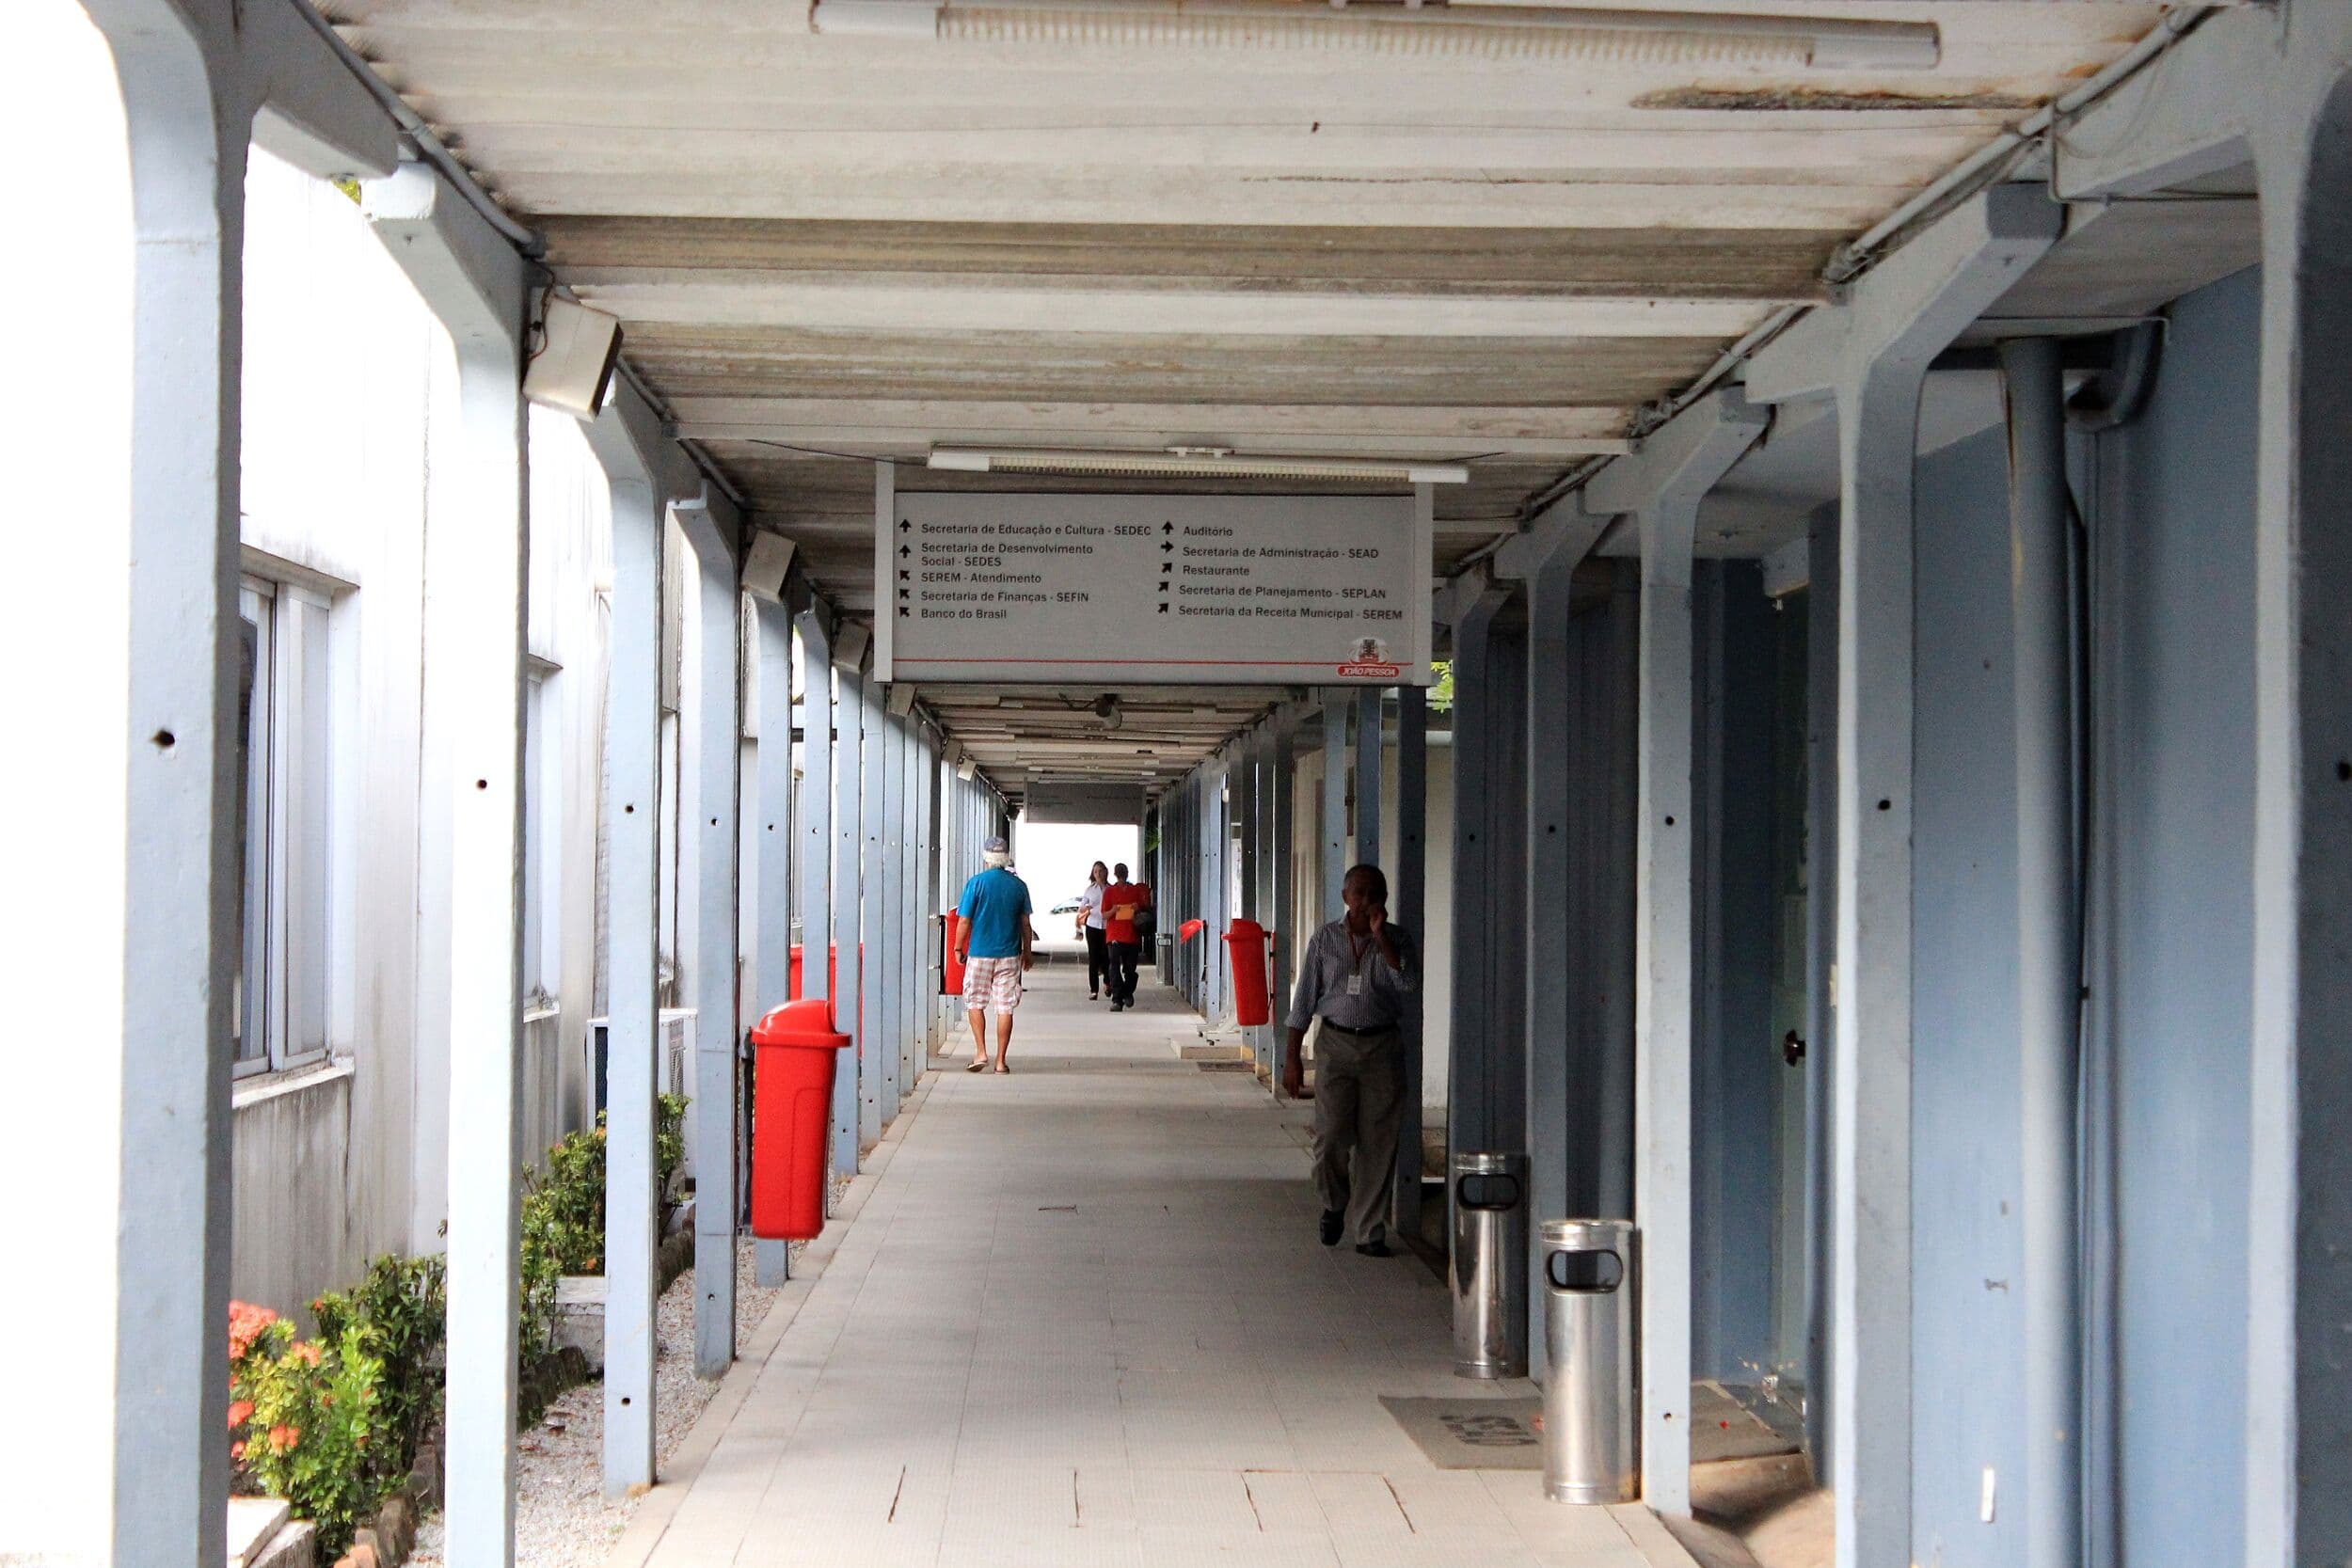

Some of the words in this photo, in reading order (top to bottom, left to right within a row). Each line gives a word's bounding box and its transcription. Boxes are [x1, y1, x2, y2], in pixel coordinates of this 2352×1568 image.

[921, 523, 978, 534] Secretaria
[981, 524, 995, 534] de
[998, 524, 1052, 536] Educação
[1064, 525, 1104, 535] Cultura
[1114, 526, 1152, 536] SEDEC
[1183, 526, 1233, 536] Auditório
[921, 543, 978, 553] Secretaria
[981, 544, 995, 553] de
[998, 543, 1093, 554] Desenvolvimento
[1183, 546, 1239, 557] Secretaria
[1242, 547, 1256, 558] de
[1259, 547, 1339, 559] Administração
[1348, 548, 1379, 559] SEAD
[921, 556, 955, 566] Social
[964, 557, 1002, 567] SEDES
[1183, 565, 1250, 576] Restaurante
[921, 573, 961, 582] SEREM
[970, 573, 1041, 583] Atendimento
[1179, 585, 1235, 595] Secretaria
[1238, 586, 1252, 596] de
[1255, 586, 1333, 598] Planejamento
[1342, 588, 1386, 598] SEPLAN
[921, 591, 977, 601] Secretaria
[981, 592, 994, 601] de
[997, 592, 1047, 604] Finanças
[1057, 593, 1089, 602] SEFIN
[921, 609, 956, 619] Banco
[959, 609, 973, 619] do
[976, 609, 1007, 619] Brasil
[1178, 606, 1234, 616] Secretaria
[1238, 607, 1251, 616] da
[1255, 607, 1296, 618] Receita
[1300, 608, 1353, 621] Municipal
[1362, 609, 1403, 620] SEREM
[1343, 666, 1364, 675] JOÃO
[1364, 667, 1396, 676] PESSOA
